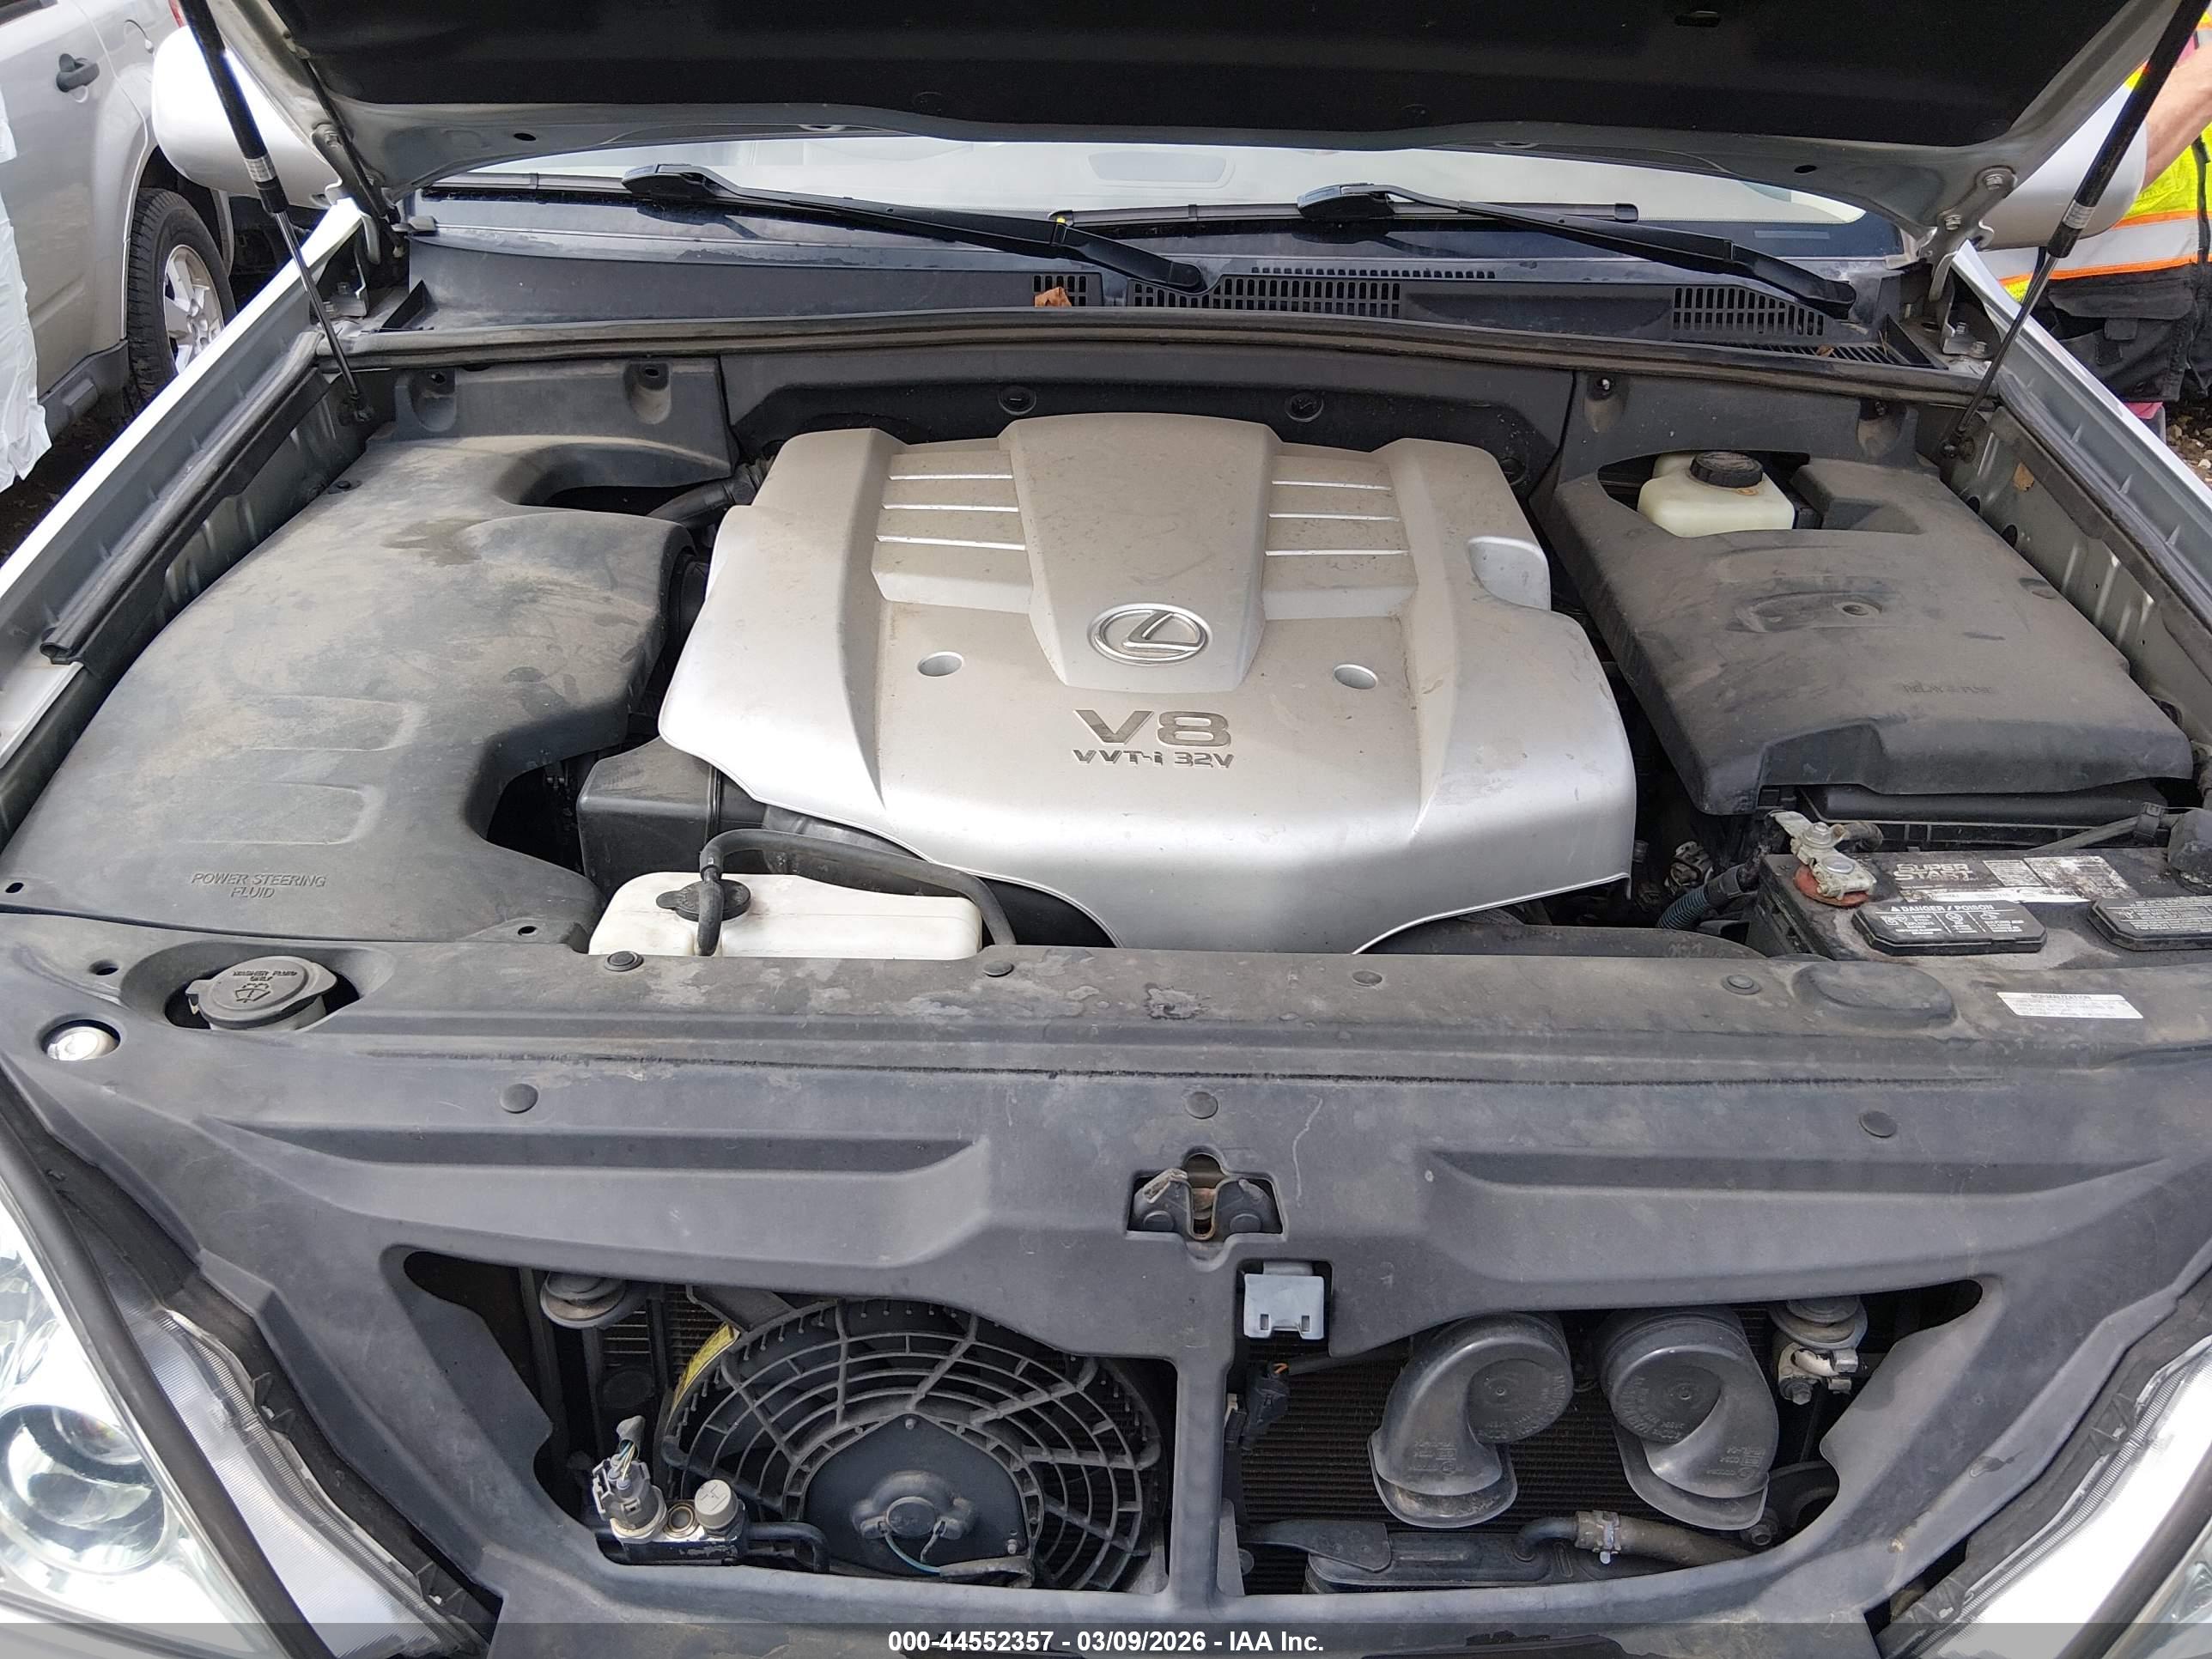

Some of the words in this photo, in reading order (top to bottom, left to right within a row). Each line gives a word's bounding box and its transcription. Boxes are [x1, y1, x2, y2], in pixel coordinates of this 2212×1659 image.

[1073, 708, 1232, 748] V8
[1073, 749, 1164, 766] VVT-i
[1174, 750, 1236, 769] 32V
[1896, 863, 1970, 872] SUPER
[191, 872, 249, 885] POWER
[252, 872, 328, 888] STEERING
[1893, 870, 1974, 881] START
[230, 886, 276, 899] FLUID
